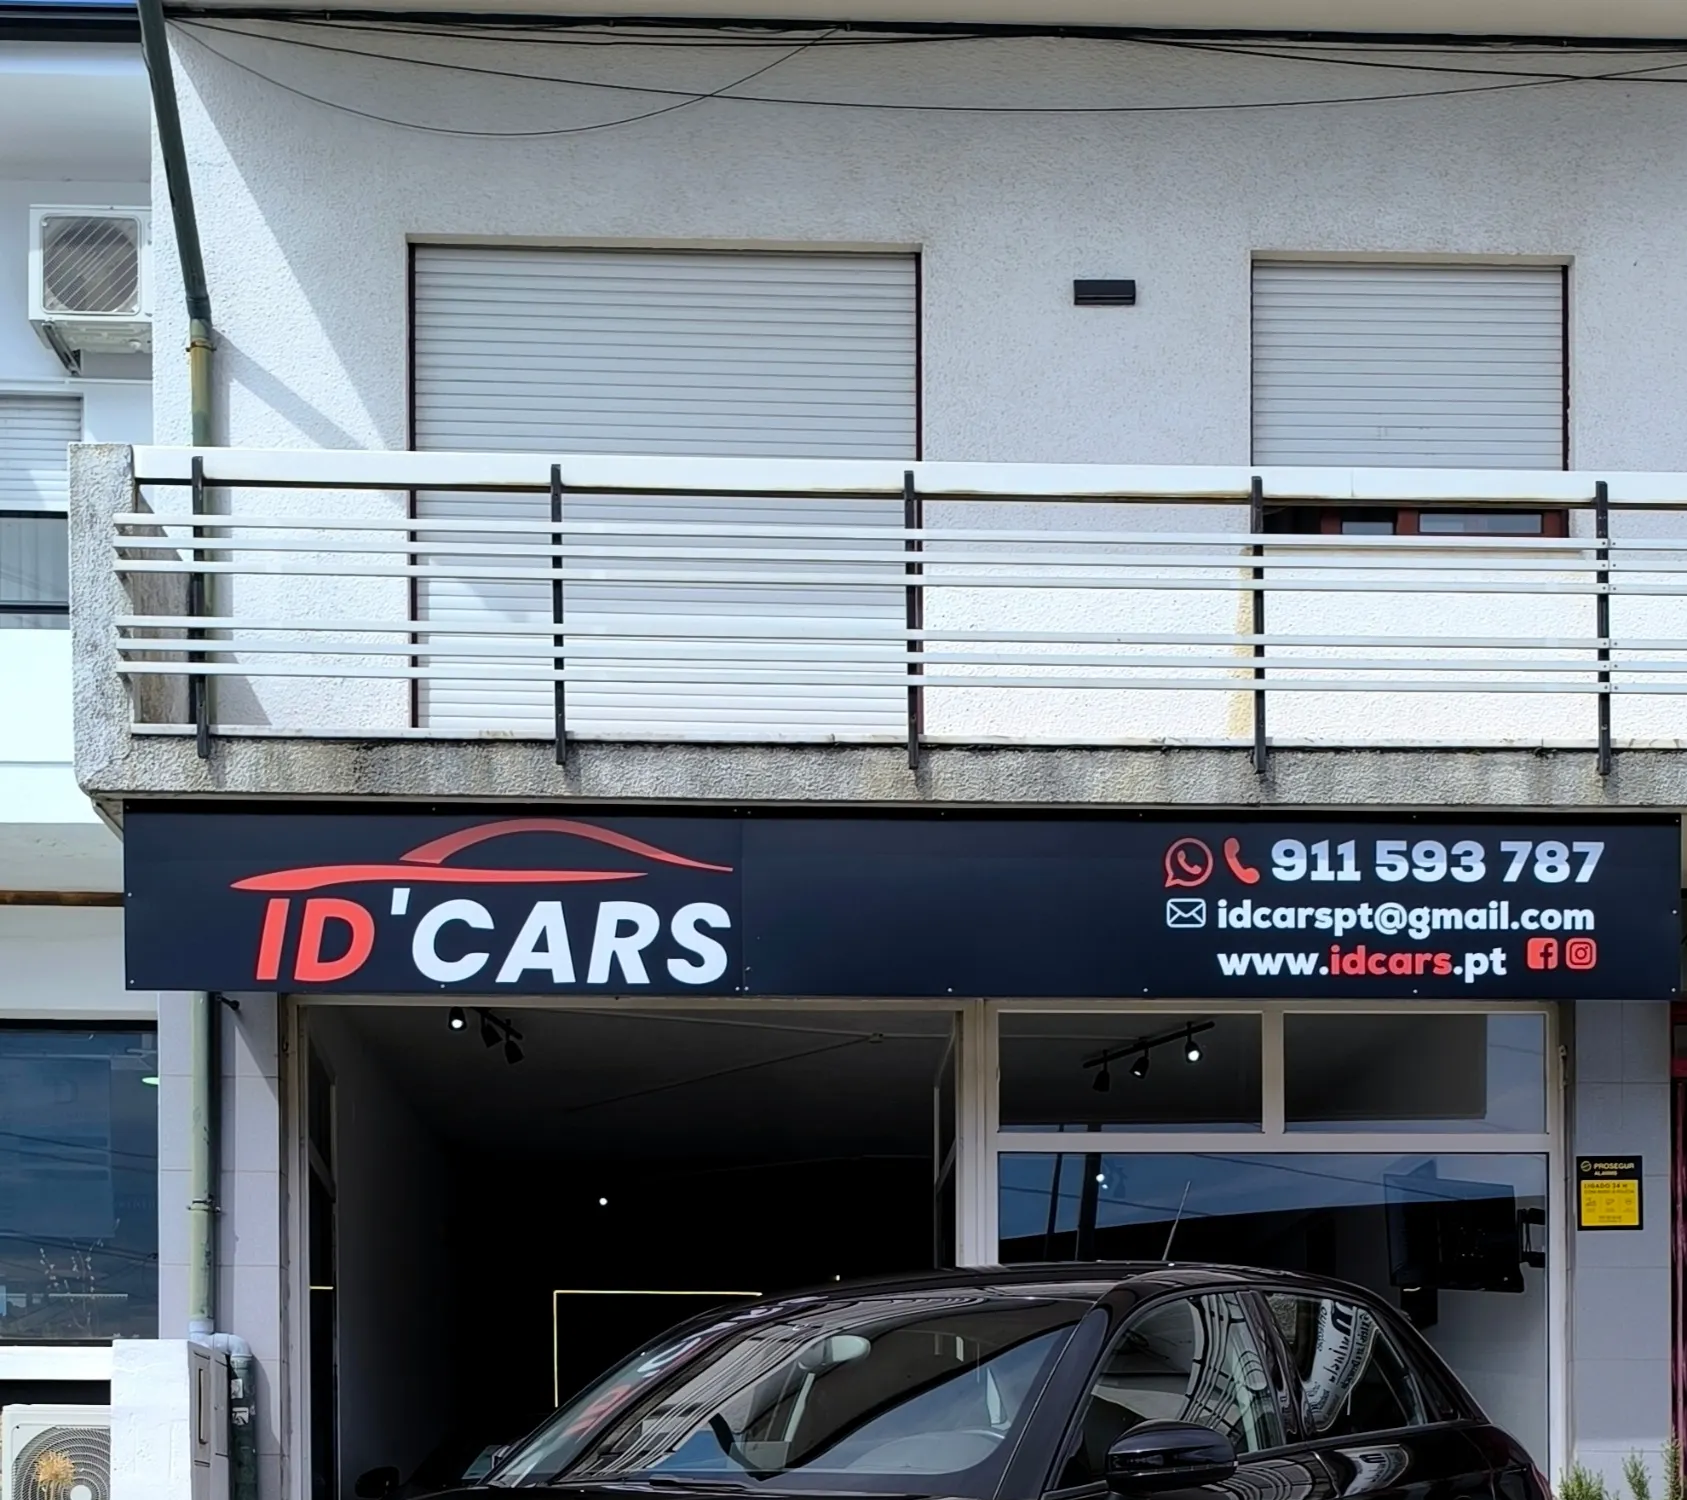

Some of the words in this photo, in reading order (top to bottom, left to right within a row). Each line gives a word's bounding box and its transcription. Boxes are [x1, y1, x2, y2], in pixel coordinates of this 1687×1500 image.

[1270, 838, 1362, 882] 911
[1375, 839, 1486, 883] 593
[1500, 840, 1605, 884] 787
[256, 887, 732, 984] ID'CARS
[1217, 898, 1595, 940] idcarspt@gmail.com
[1217, 945, 1508, 984] www.idcars.pt
[1593, 1162, 1635, 1170] PROSEGUR
